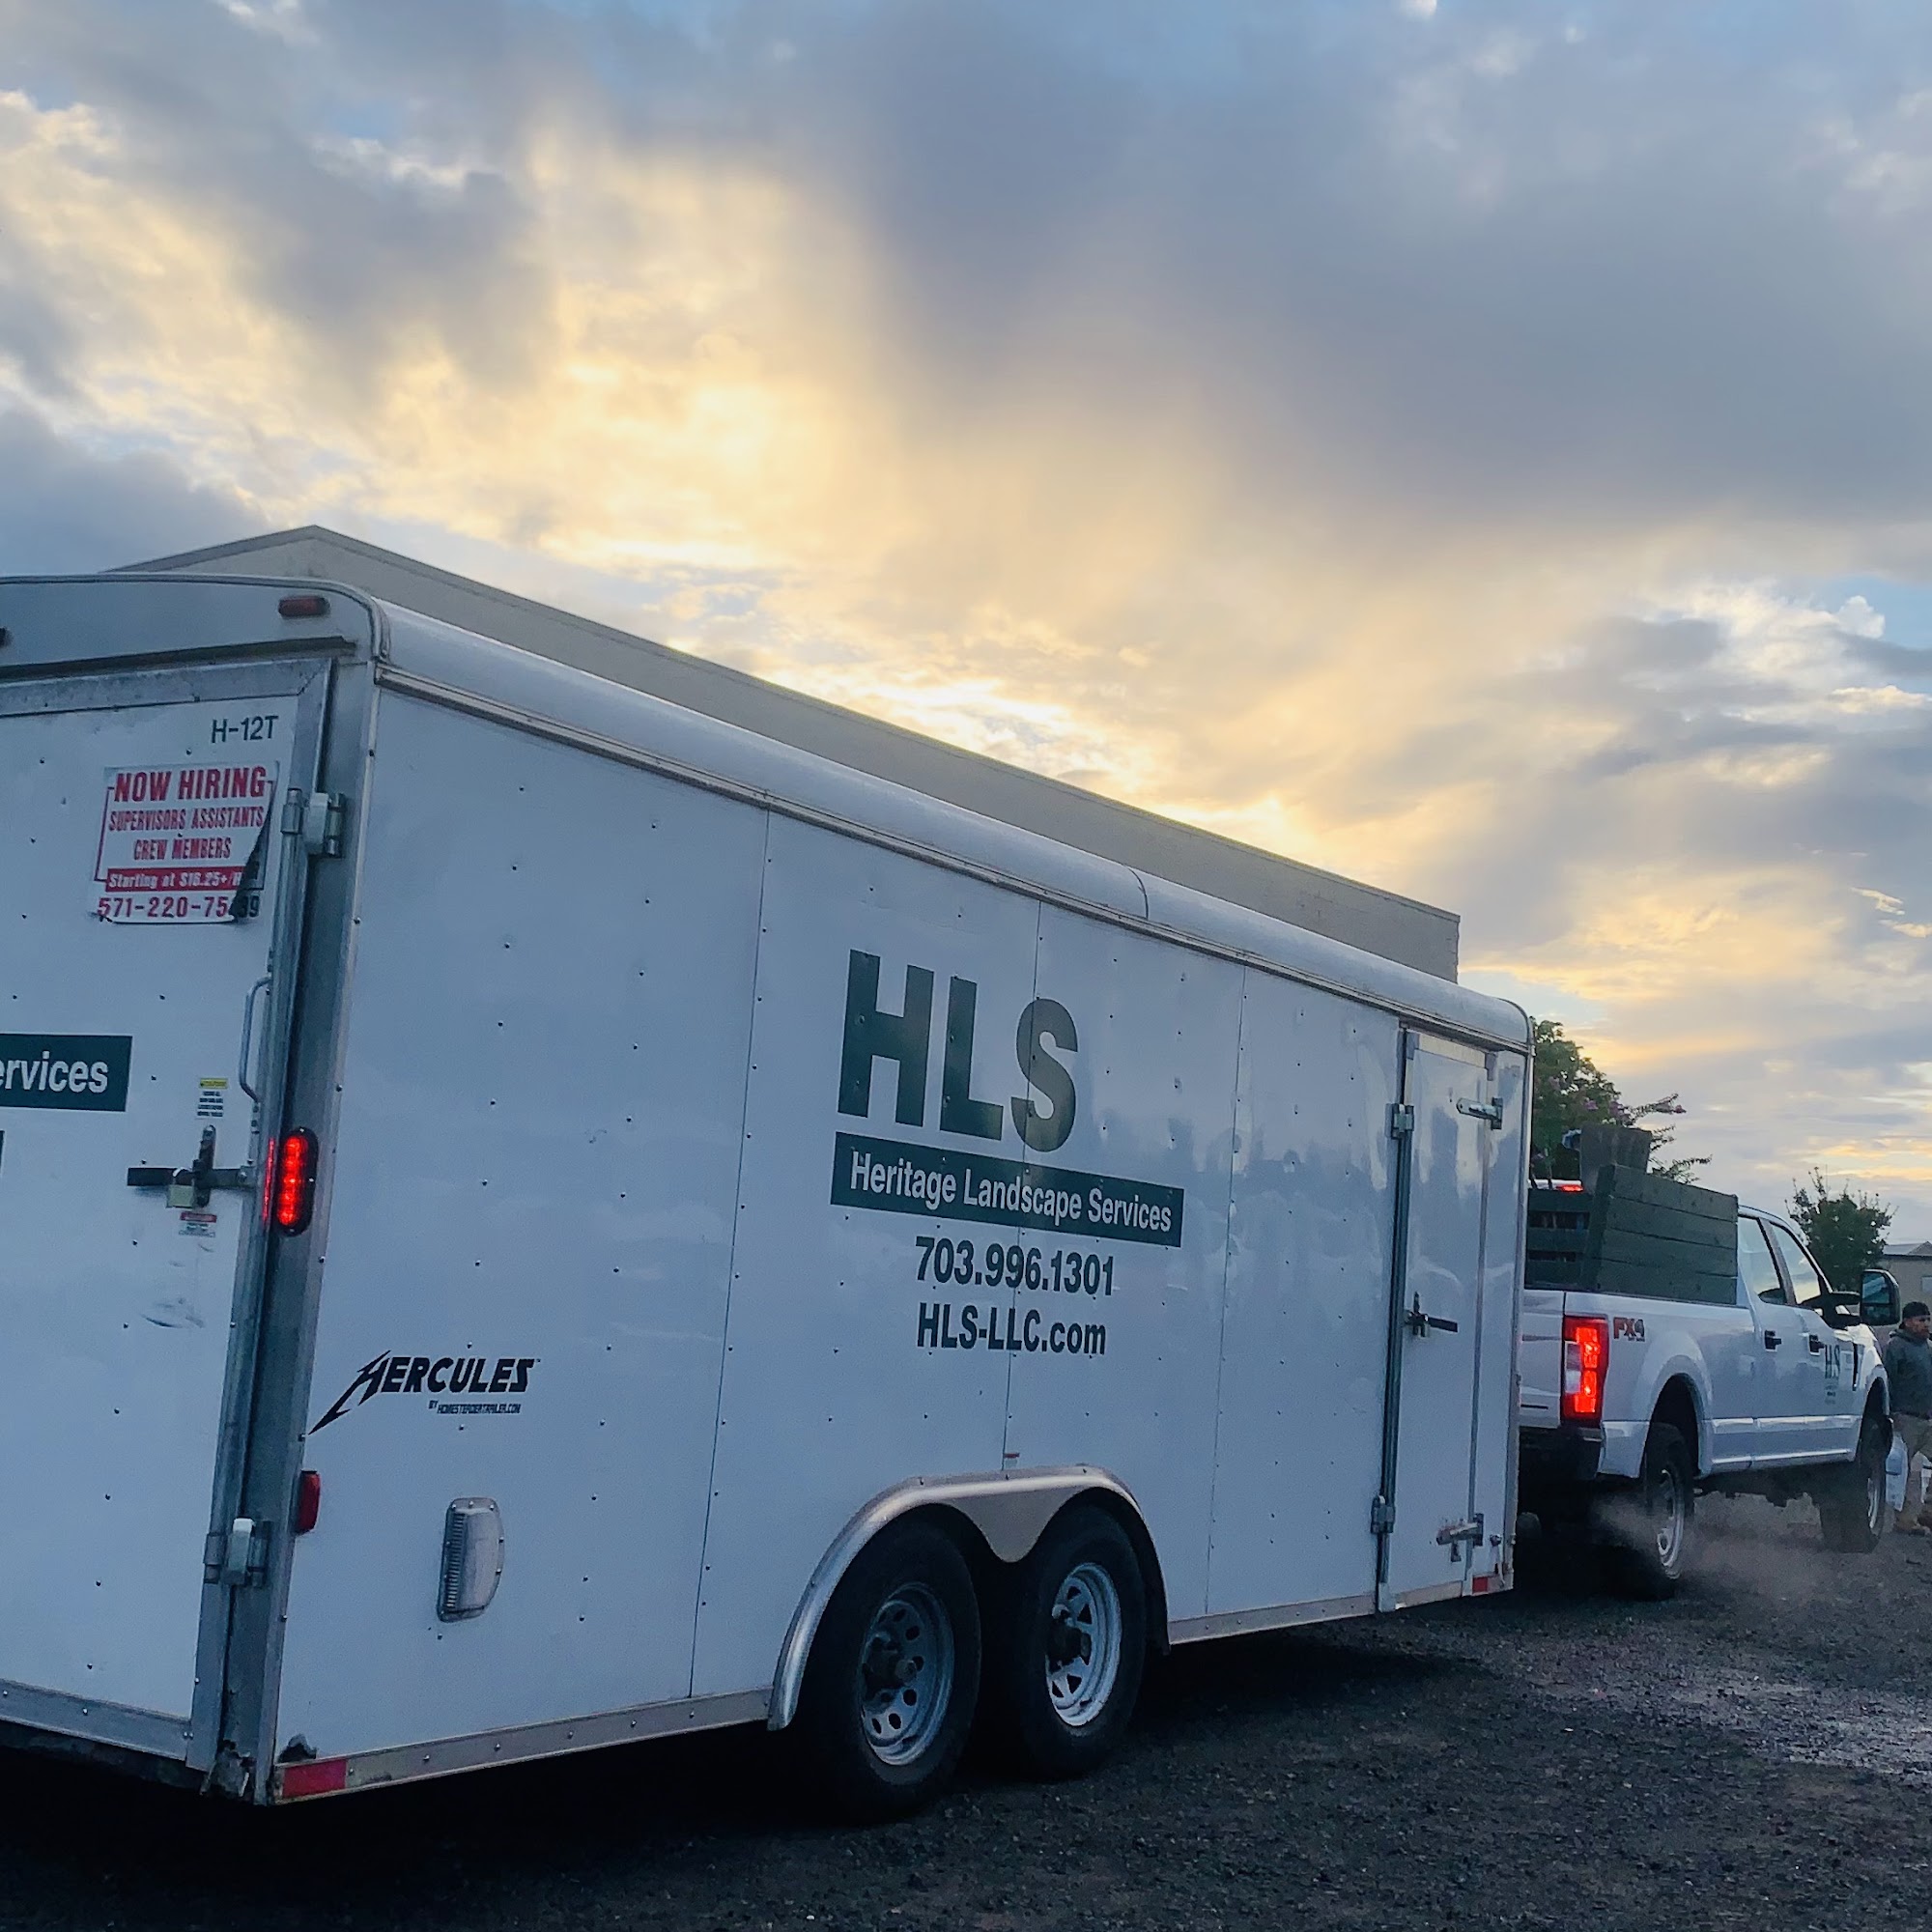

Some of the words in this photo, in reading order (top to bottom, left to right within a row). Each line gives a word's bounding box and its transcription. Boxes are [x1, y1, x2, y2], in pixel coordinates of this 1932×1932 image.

[211, 715, 279, 743] H-12T
[114, 771, 172, 802] NOW
[178, 766, 267, 800] HIRING
[108, 809, 186, 831] SUPERVISORS
[191, 806, 264, 829] ASSISTANTS
[133, 838, 168, 860] CREW
[172, 838, 232, 859] MEMBERS
[109, 873, 158, 889] Starting
[162, 872, 175, 887] at
[838, 949, 1078, 1152] HLS
[0, 1051, 108, 1093] rvices
[850, 1151, 956, 1209] Heritage
[964, 1169, 1082, 1226] Landscape
[1088, 1188, 1172, 1233] Services
[916, 1236, 1115, 1296] 703.996.1301
[917, 1301, 1107, 1354] HLS-LLC.com
[308, 1350, 535, 1435] HERCULES
